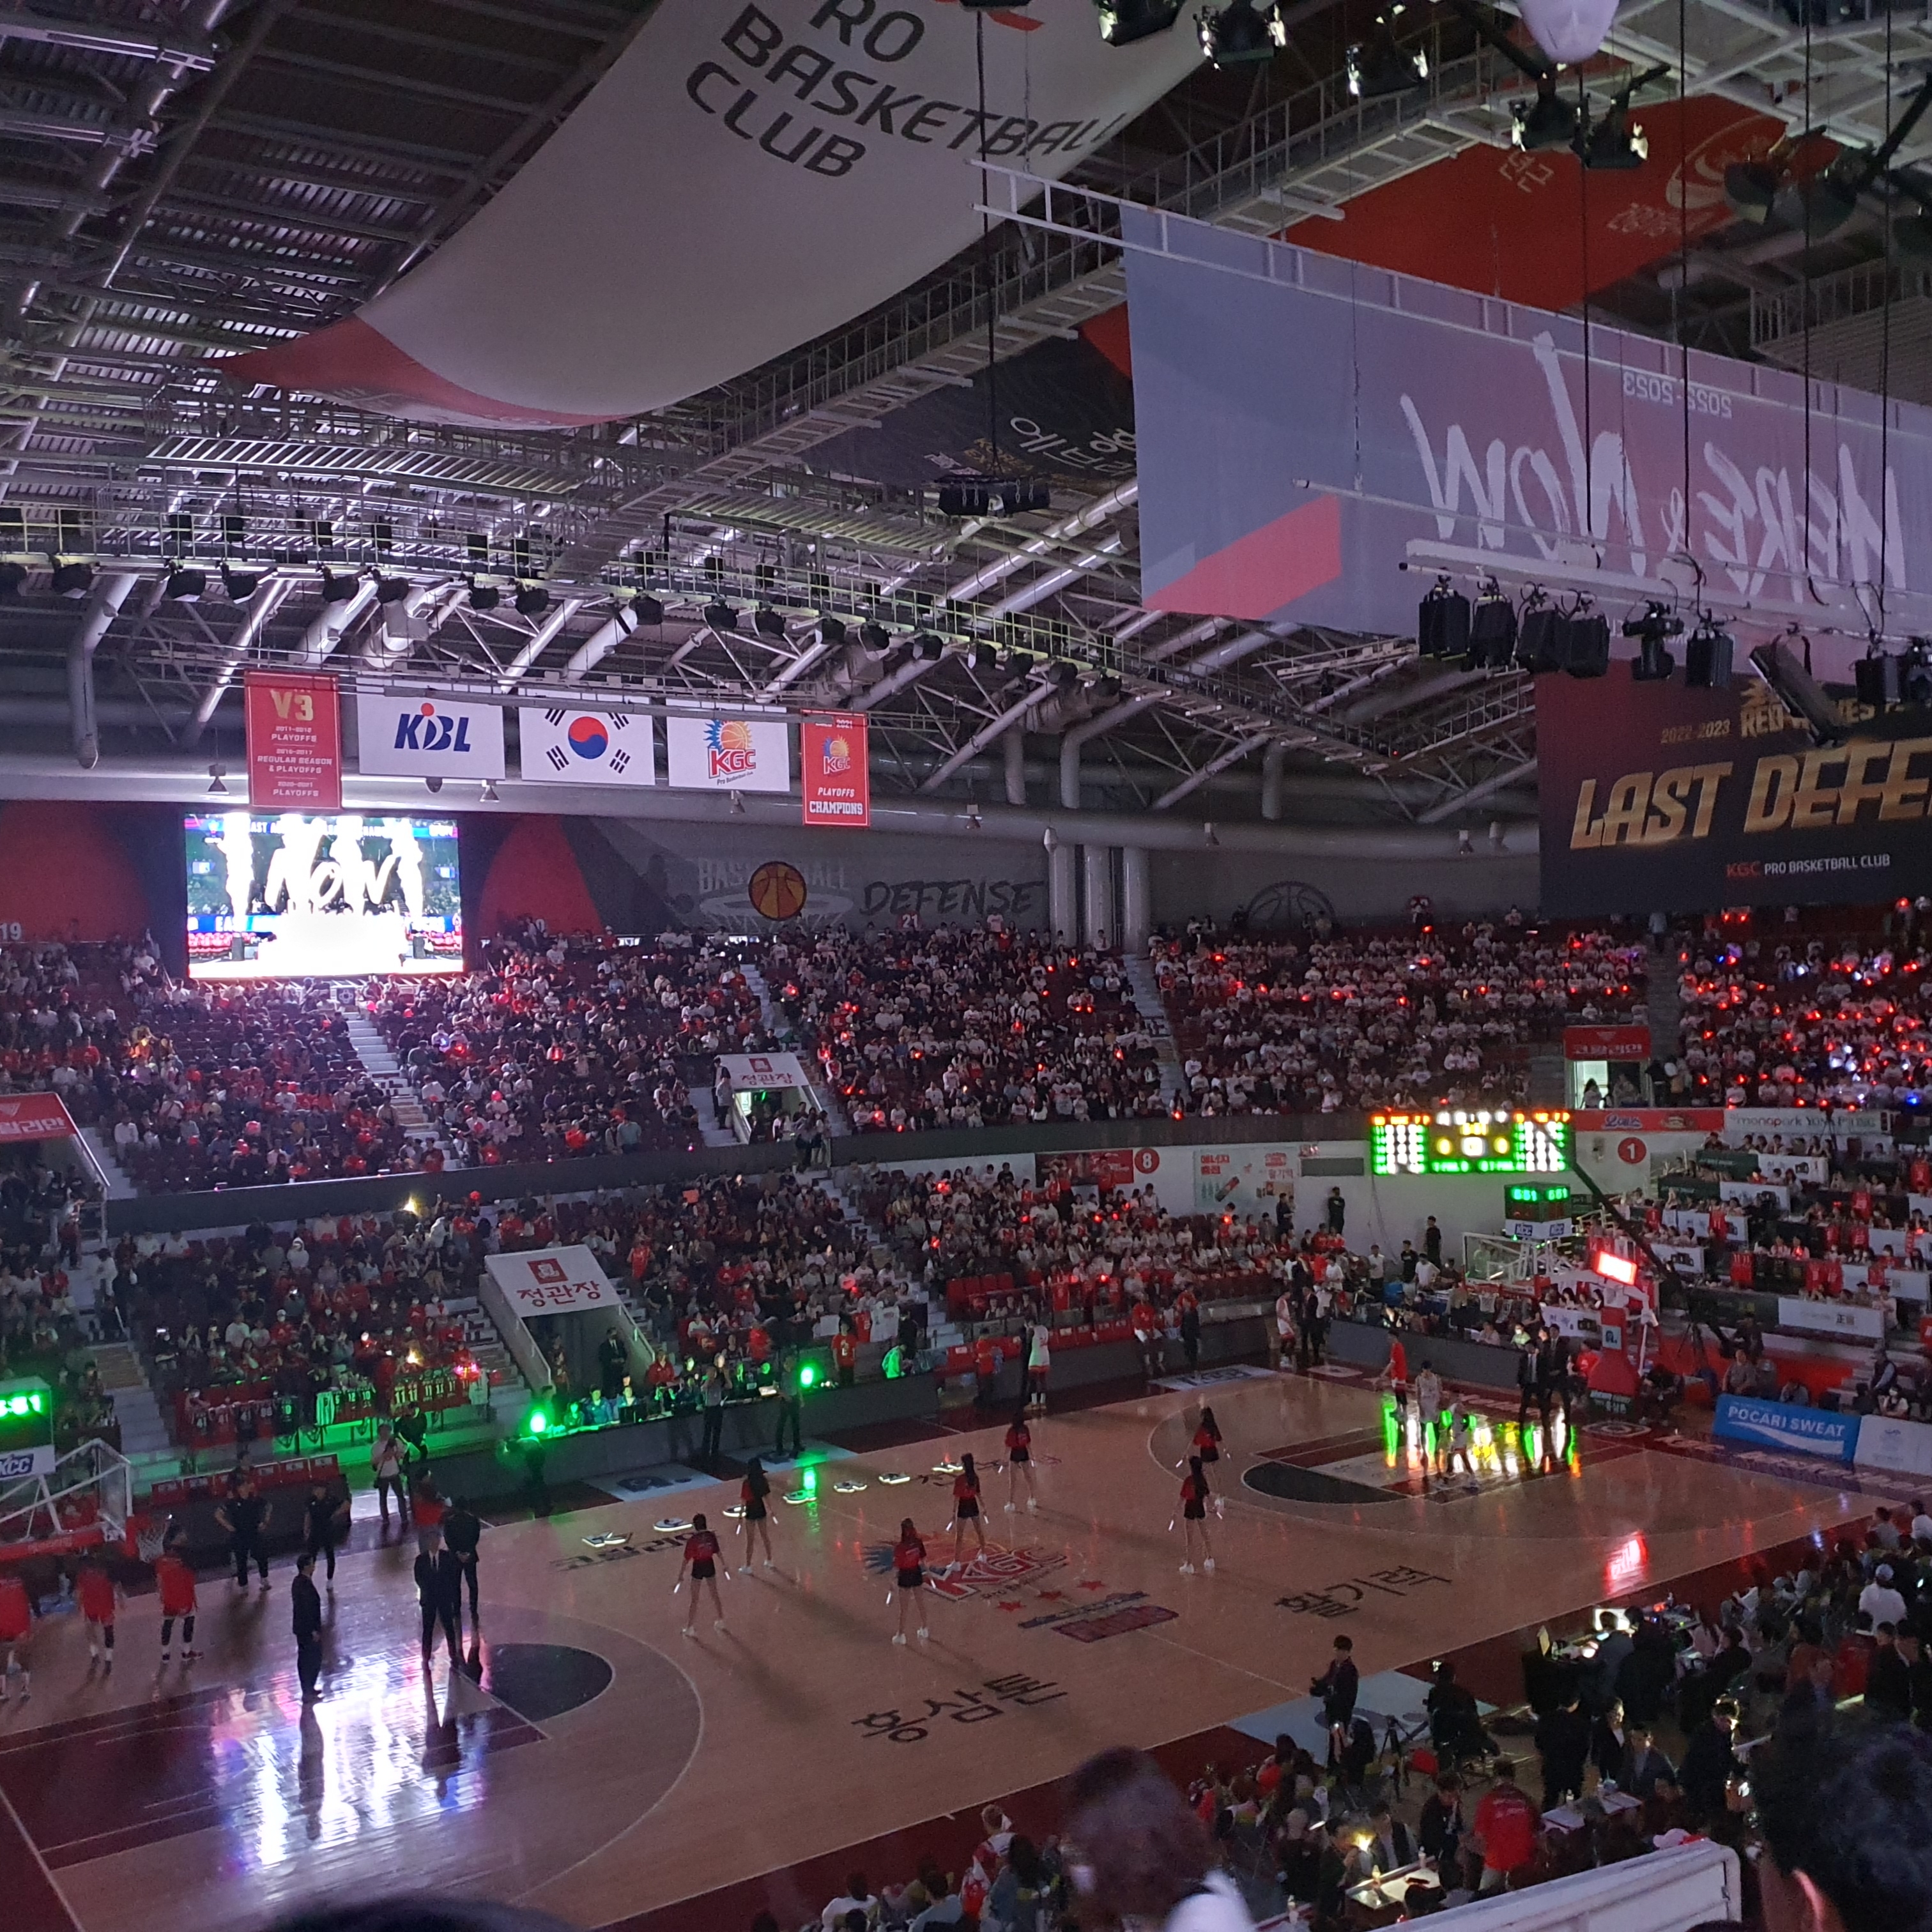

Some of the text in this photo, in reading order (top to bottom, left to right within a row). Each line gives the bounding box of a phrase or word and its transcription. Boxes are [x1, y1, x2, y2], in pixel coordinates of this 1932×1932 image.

[686, 62, 866, 177] CLUB
[269, 689, 314, 722] V3
[271, 733, 317, 743] PLAYOFFS
[394, 712, 471, 753] KBL
[1660, 718, 1731, 744] 2022-2023
[257, 755, 333, 767] REGULAR SEASON
[268, 764, 322, 775] & PLAYOFFS
[709, 748, 756, 779] KGC
[823, 756, 851, 776] KGC
[273, 788, 319, 797] PLAYOFFS
[817, 786, 855, 798] PLAYOFFS
[1569, 736, 1932, 850] LAST DEFE
[809, 800, 863, 815] CHAMPIONS
[1726, 854, 1891, 878] KGC PRO BASKETBALL CLUB
[859, 879, 1045, 916] DEFENSE
[741, 1072, 793, 1085] 정관장
[1142, 1152, 1152, 1169] 8
[1627, 1142, 1637, 1160] 1
[517, 1280, 601, 1307] 정관장
[1728, 1405, 1787, 1429] POCARI
[1790, 1417, 1846, 1438] SWEAT
[851, 1673, 1068, 1744] 홍삼톤
